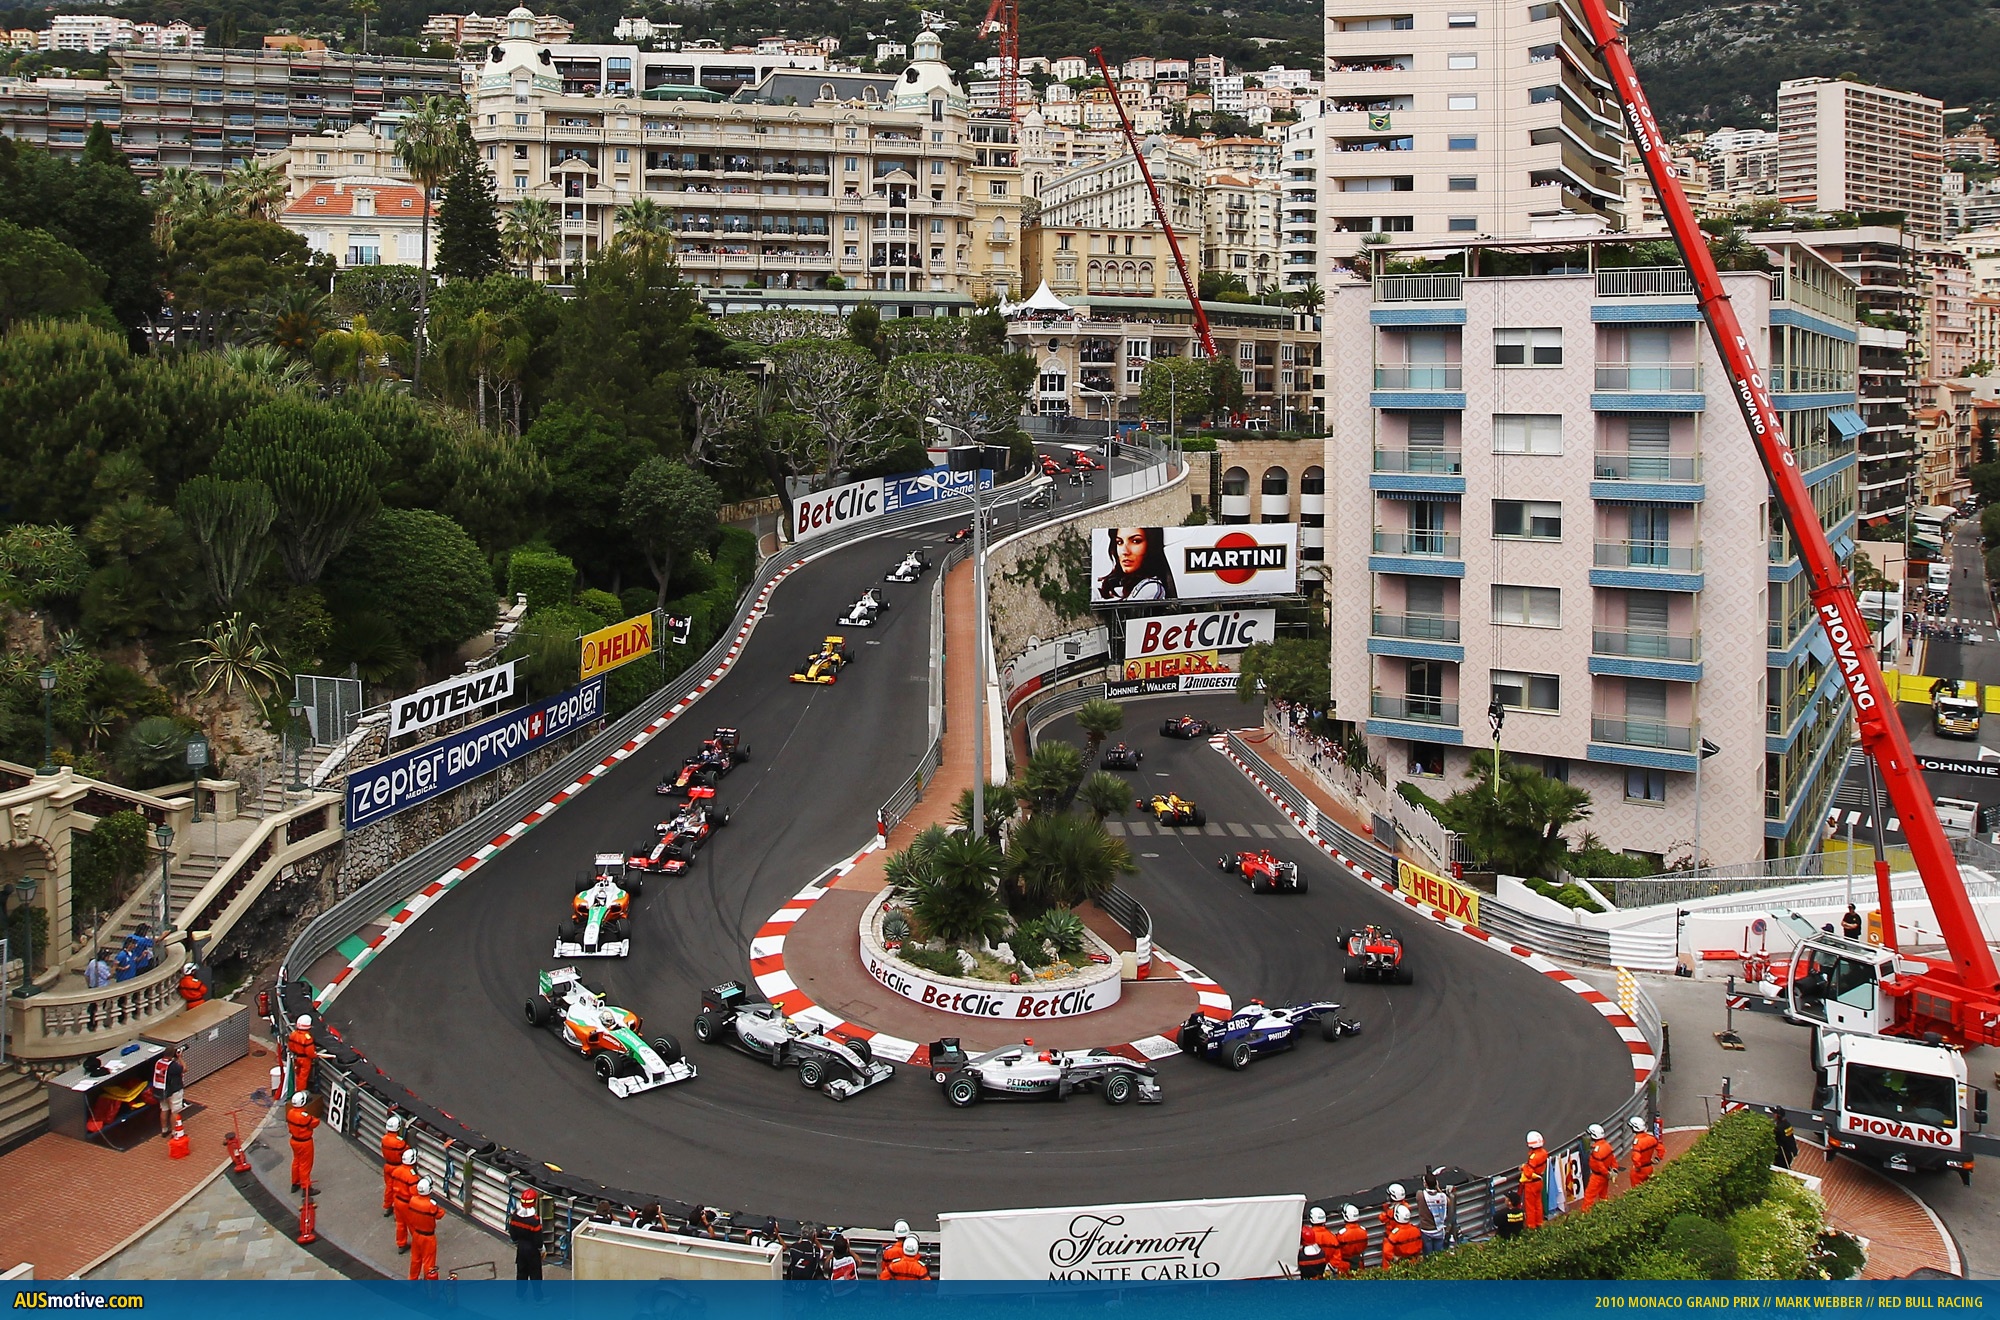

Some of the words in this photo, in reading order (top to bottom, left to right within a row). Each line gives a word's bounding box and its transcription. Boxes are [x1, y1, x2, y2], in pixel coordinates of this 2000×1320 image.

[1626, 102, 1652, 152] PIOVANO
[1628, 76, 1677, 178] PIOVANO
[1182, 265, 1197, 298] PIOVANO
[1736, 335, 1795, 467] PIOVANO
[1738, 379, 1766, 435] PIOVANO
[798, 482, 879, 535] BetClic
[1190, 549, 1282, 568] MARTINI
[599, 622, 650, 667] HELIX
[1141, 611, 1258, 654] BetClic
[1821, 604, 1875, 711] PIOVANO
[398, 670, 509, 730] POTENZA
[1108, 686, 1139, 697] JOHNNIE
[1146, 682, 1177, 692] WALKER
[1184, 676, 1237, 689] BRIDGESTO
[544, 680, 602, 738] zepter
[576, 707, 596, 723] MEDICAL
[448, 715, 530, 778] BIOPTRON
[353, 747, 445, 820] zepter
[1921, 759, 1999, 776] JOHNNIE
[405, 782, 438, 800] MEDICAL
[1413, 872, 1473, 923] HELIX
[869, 959, 912, 996] BetClic
[921, 985, 1004, 1016] BetClic
[1015, 989, 1096, 1018] BetClic
[1235, 1018, 1250, 1029] RBS
[1007, 1078, 1051, 1088] PETRONAS
[1849, 1116, 1953, 1146] PIOVANO
[1049, 1214, 1219, 1268] Fairmont
[1048, 1267, 1131, 1284] MONTE
[1141, 1261, 1221, 1280] CARLO
